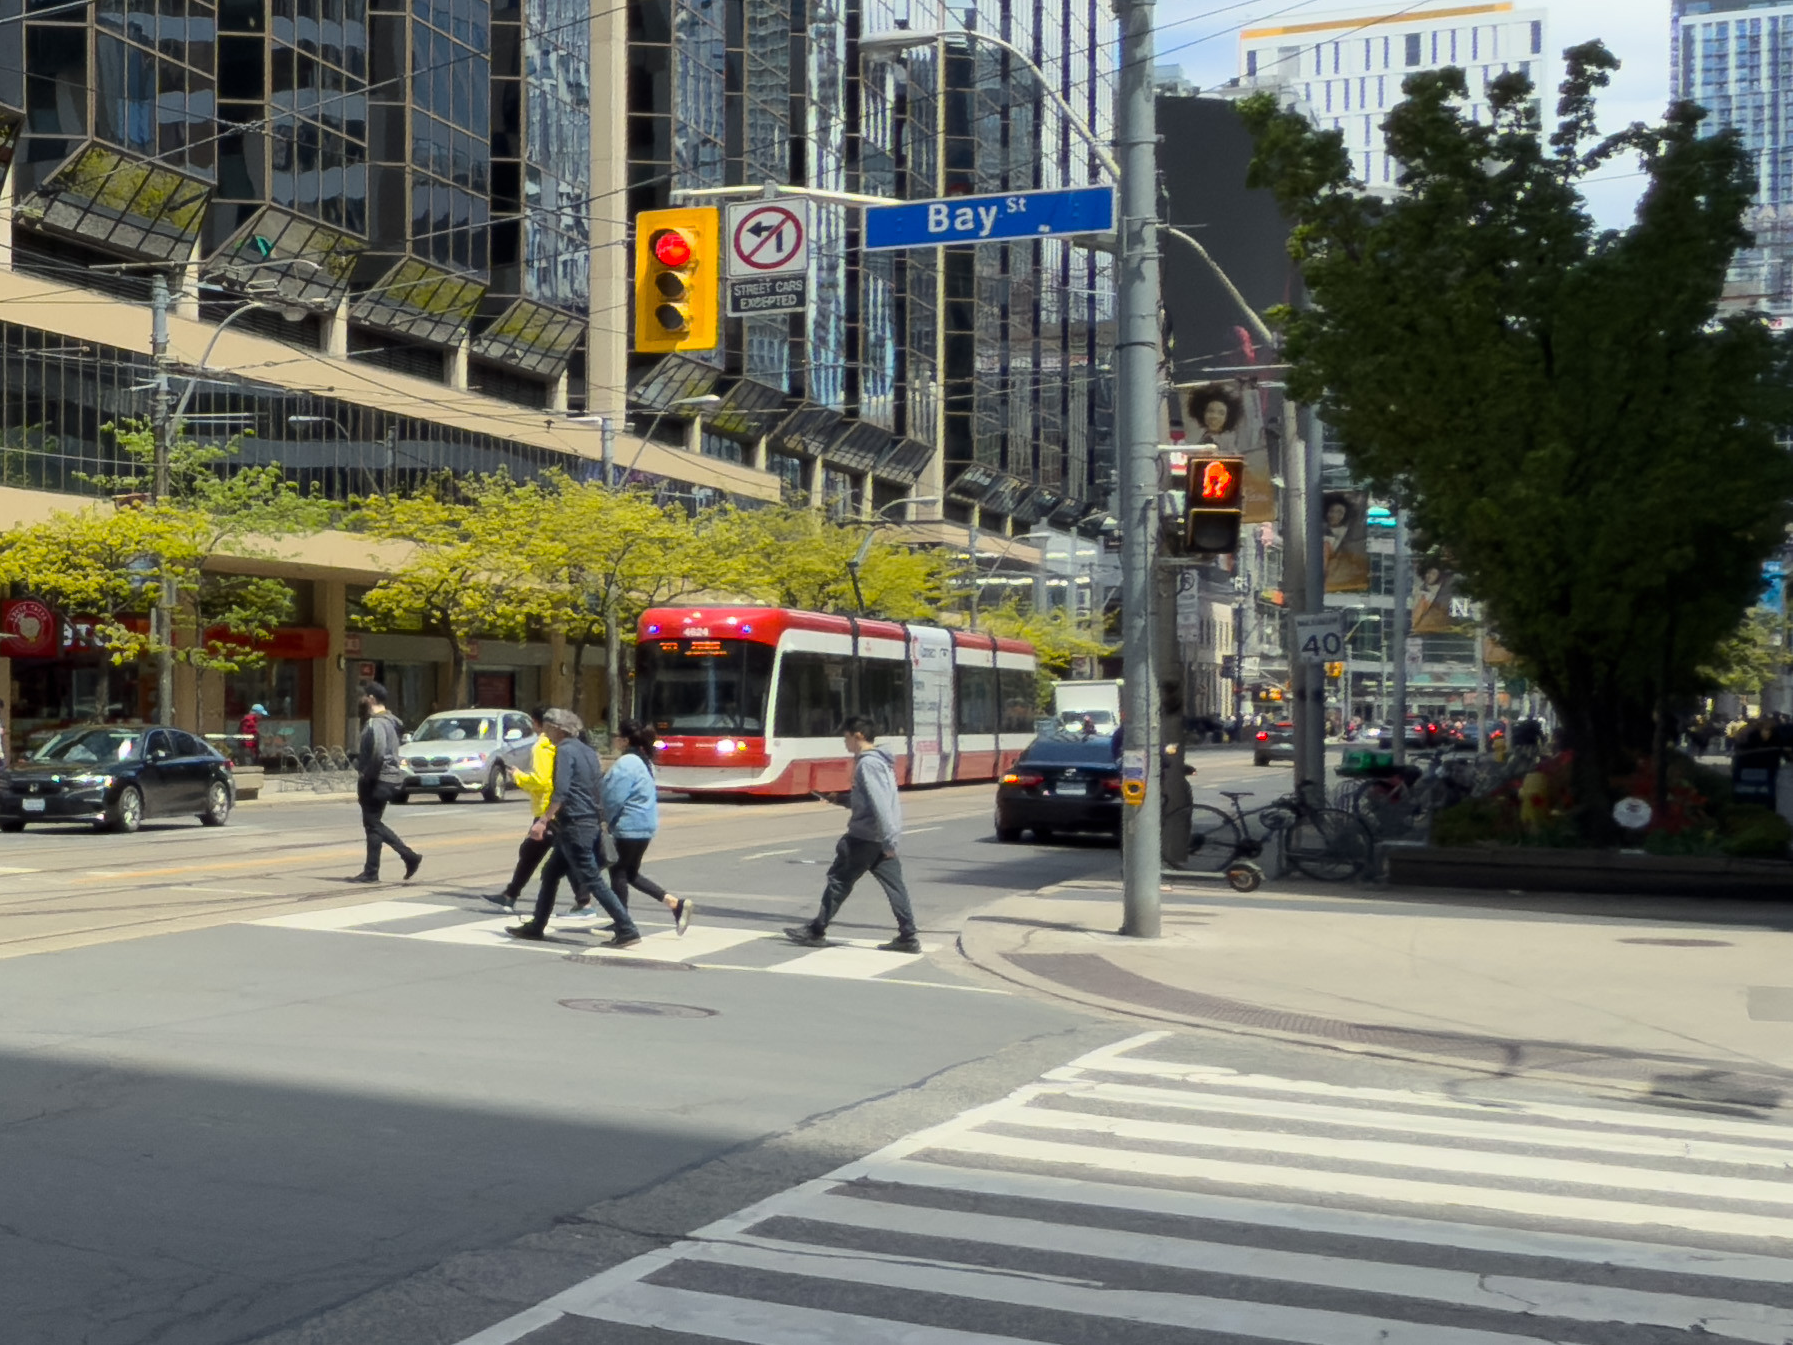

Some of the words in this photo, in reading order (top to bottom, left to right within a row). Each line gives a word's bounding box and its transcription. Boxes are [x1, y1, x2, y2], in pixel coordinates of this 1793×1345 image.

[927, 202, 998, 237] Bay
[1006, 197, 1027, 213] St
[734, 282, 773, 296] STREET
[775, 280, 803, 293] CARS
[740, 294, 798, 310] EXCEPTED
[1302, 632, 1342, 656] 40
